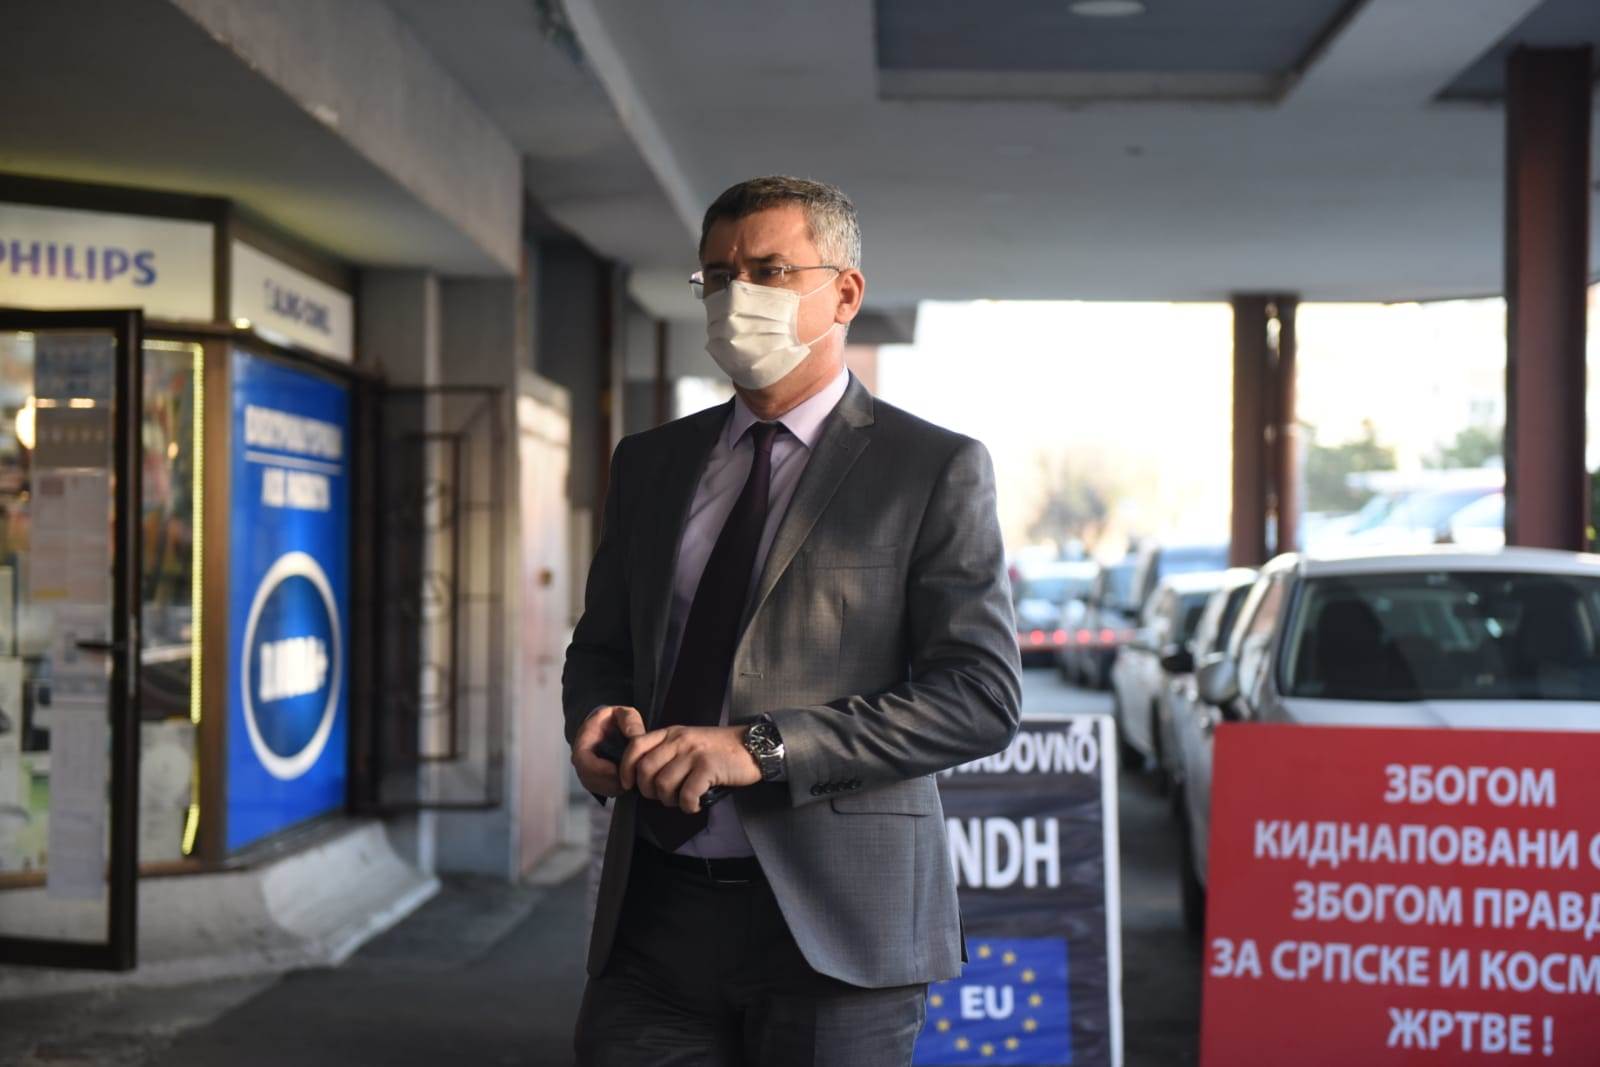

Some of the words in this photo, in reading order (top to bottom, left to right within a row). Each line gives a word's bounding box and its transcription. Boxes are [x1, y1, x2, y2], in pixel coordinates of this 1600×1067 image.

[0, 238, 157, 287] HILIPS
[1384, 763, 1557, 807] ЗБОГОМ
[946, 818, 1060, 888] NDH
[1254, 819, 1579, 869] КИДНАПОВАНИ
[1292, 880, 1463, 926] ЗБОГОМ
[1210, 938, 1262, 979] ЗА
[1271, 941, 1430, 987] СРПСКЕ
[1440, 948, 1469, 989] И
[960, 986, 1015, 1020] EU
[1387, 1007, 1532, 1055] ЖРТВЕ
